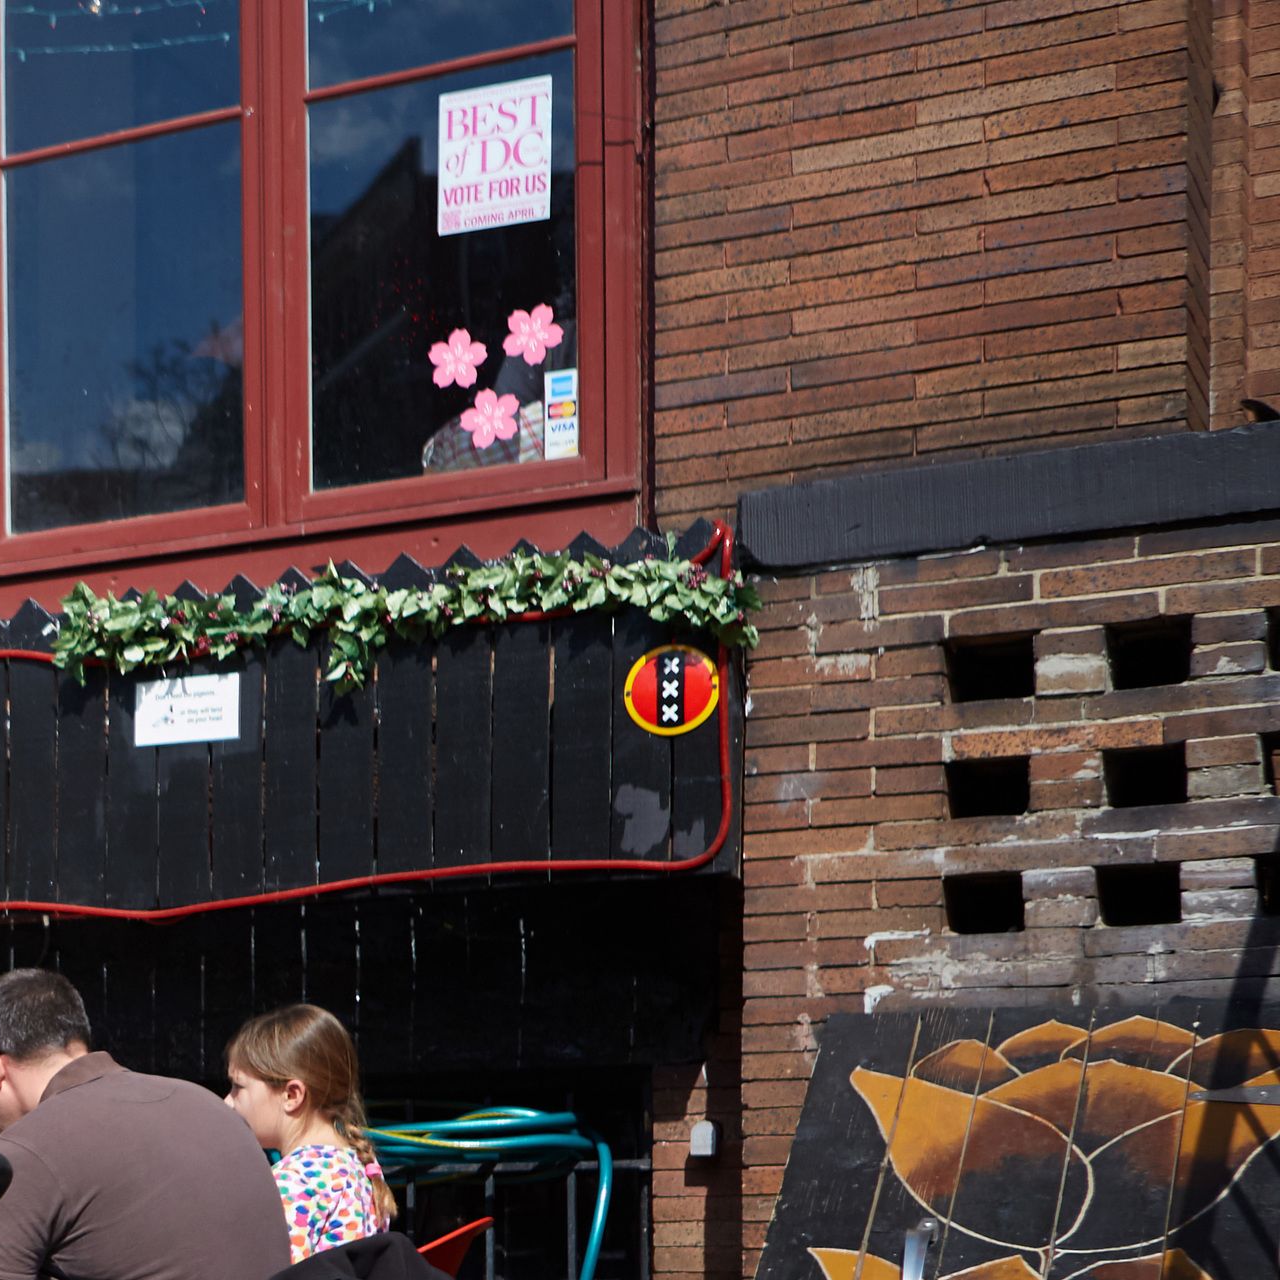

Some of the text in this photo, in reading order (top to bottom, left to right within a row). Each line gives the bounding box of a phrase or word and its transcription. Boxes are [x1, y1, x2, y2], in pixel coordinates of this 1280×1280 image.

[446, 92, 550, 142] BEST
[446, 127, 548, 178] of D.C.
[443, 183, 482, 206] VOTE
[489, 177, 520, 200] FOR
[525, 172, 547, 194] US
[464, 213, 505, 229] COMING
[508, 207, 536, 221] APRIL
[551, 421, 576, 433] VISA
